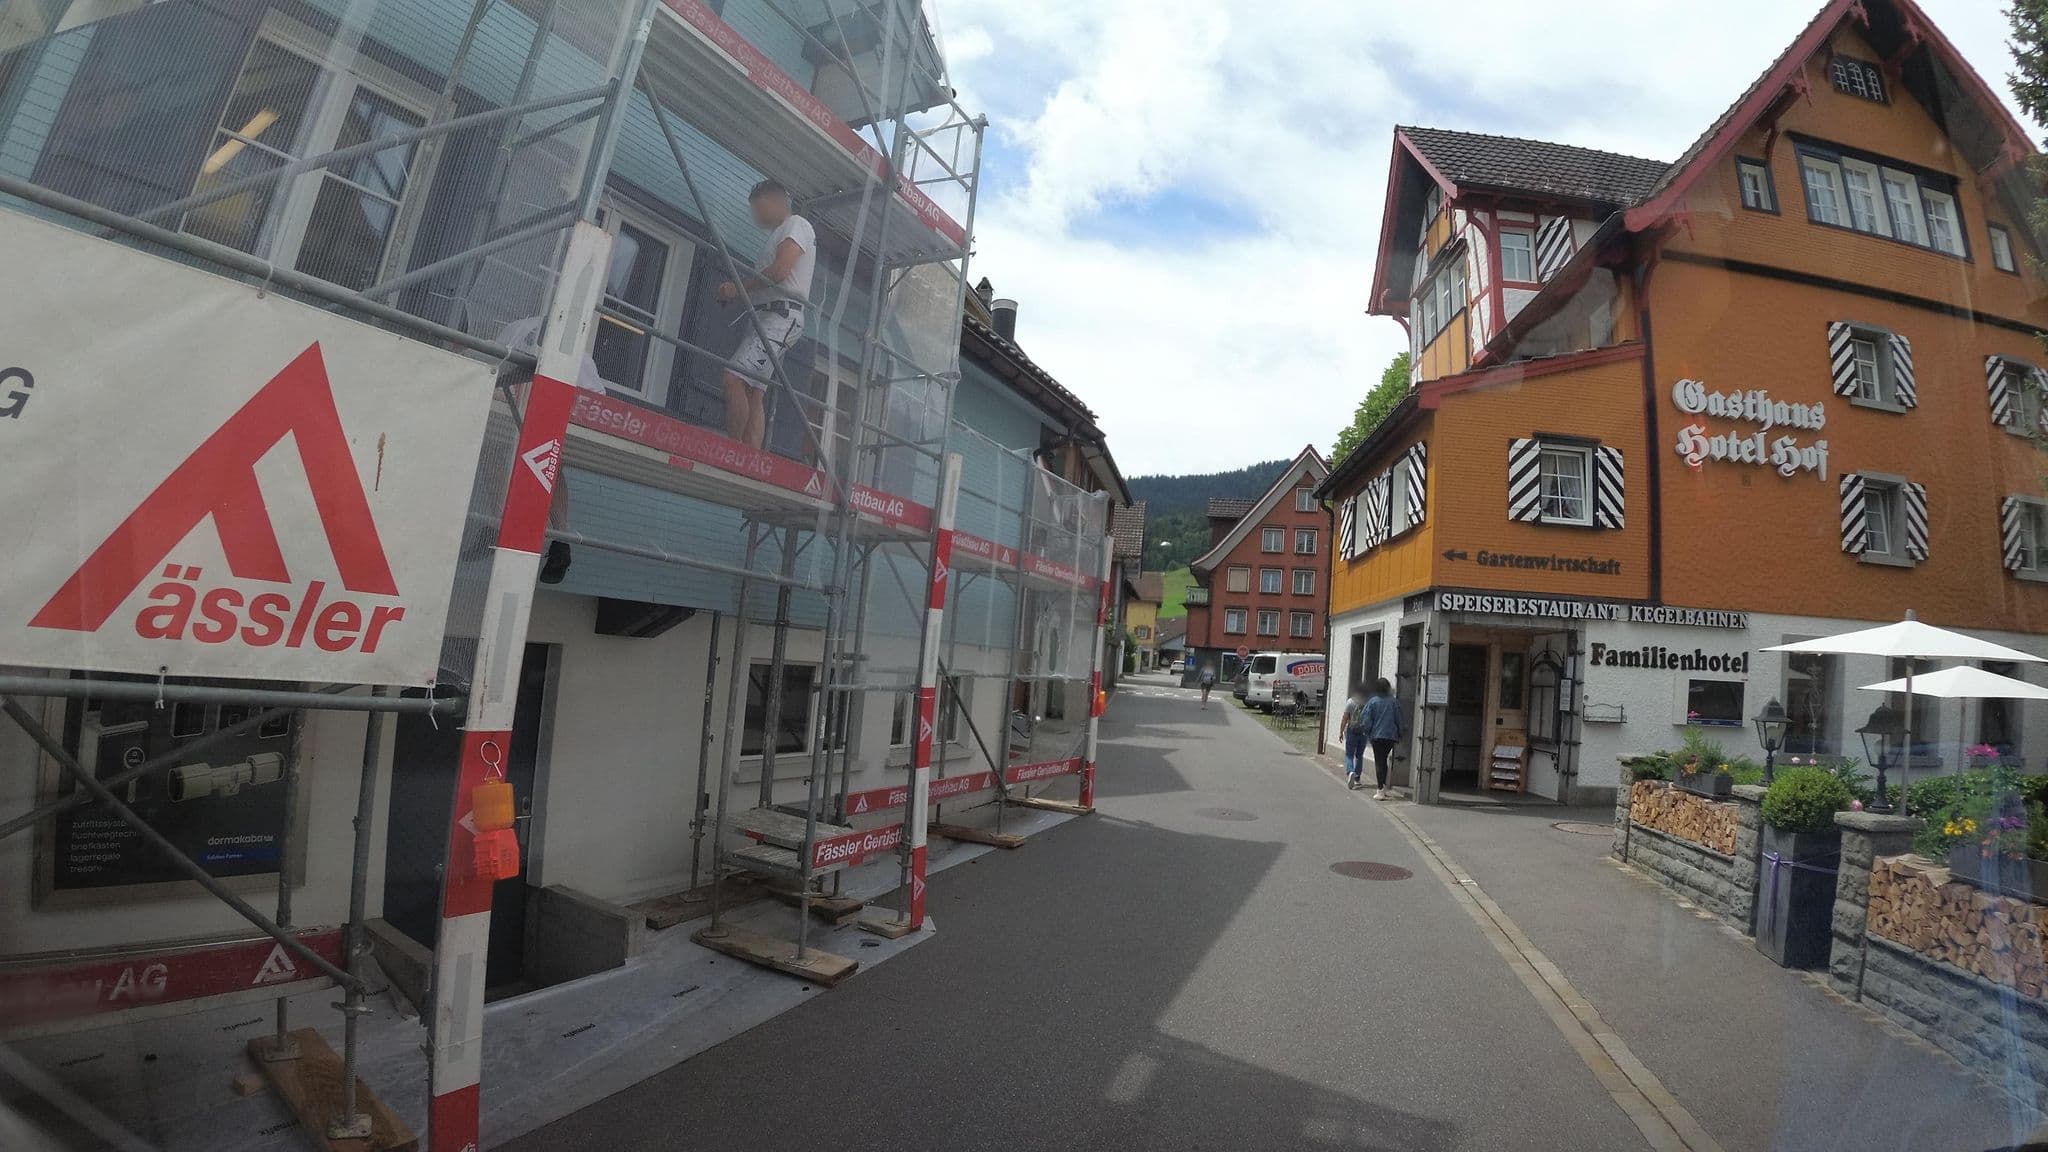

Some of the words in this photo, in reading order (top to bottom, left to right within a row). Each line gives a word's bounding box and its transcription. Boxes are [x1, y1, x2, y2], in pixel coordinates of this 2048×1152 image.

[811, 103, 832, 128] AG
[924, 203, 941, 222] AG
[1672, 378, 1826, 431] Gasthaus
[572, 394, 648, 437] Fässler
[748, 451, 774, 477] AG
[1674, 422, 1769, 467] Hotel
[1769, 433, 1829, 482] Hof
[886, 498, 904, 518] AG
[979, 540, 991, 555] AG
[1476, 549, 1621, 576] Gartenwirtschaft
[1441, 592, 1620, 621] SPEISERESTAURANT
[1631, 605, 1749, 629] KEGELBAHNEN
[1589, 642, 1750, 674] Familienhotel
[1062, 761, 1070, 773] AG
[888, 789, 908, 806] Fäss
[958, 777, 970, 791] AG
[207, 834, 263, 846] dormakaba
[815, 838, 862, 864] Fässler
[108, 963, 169, 1002] AG
